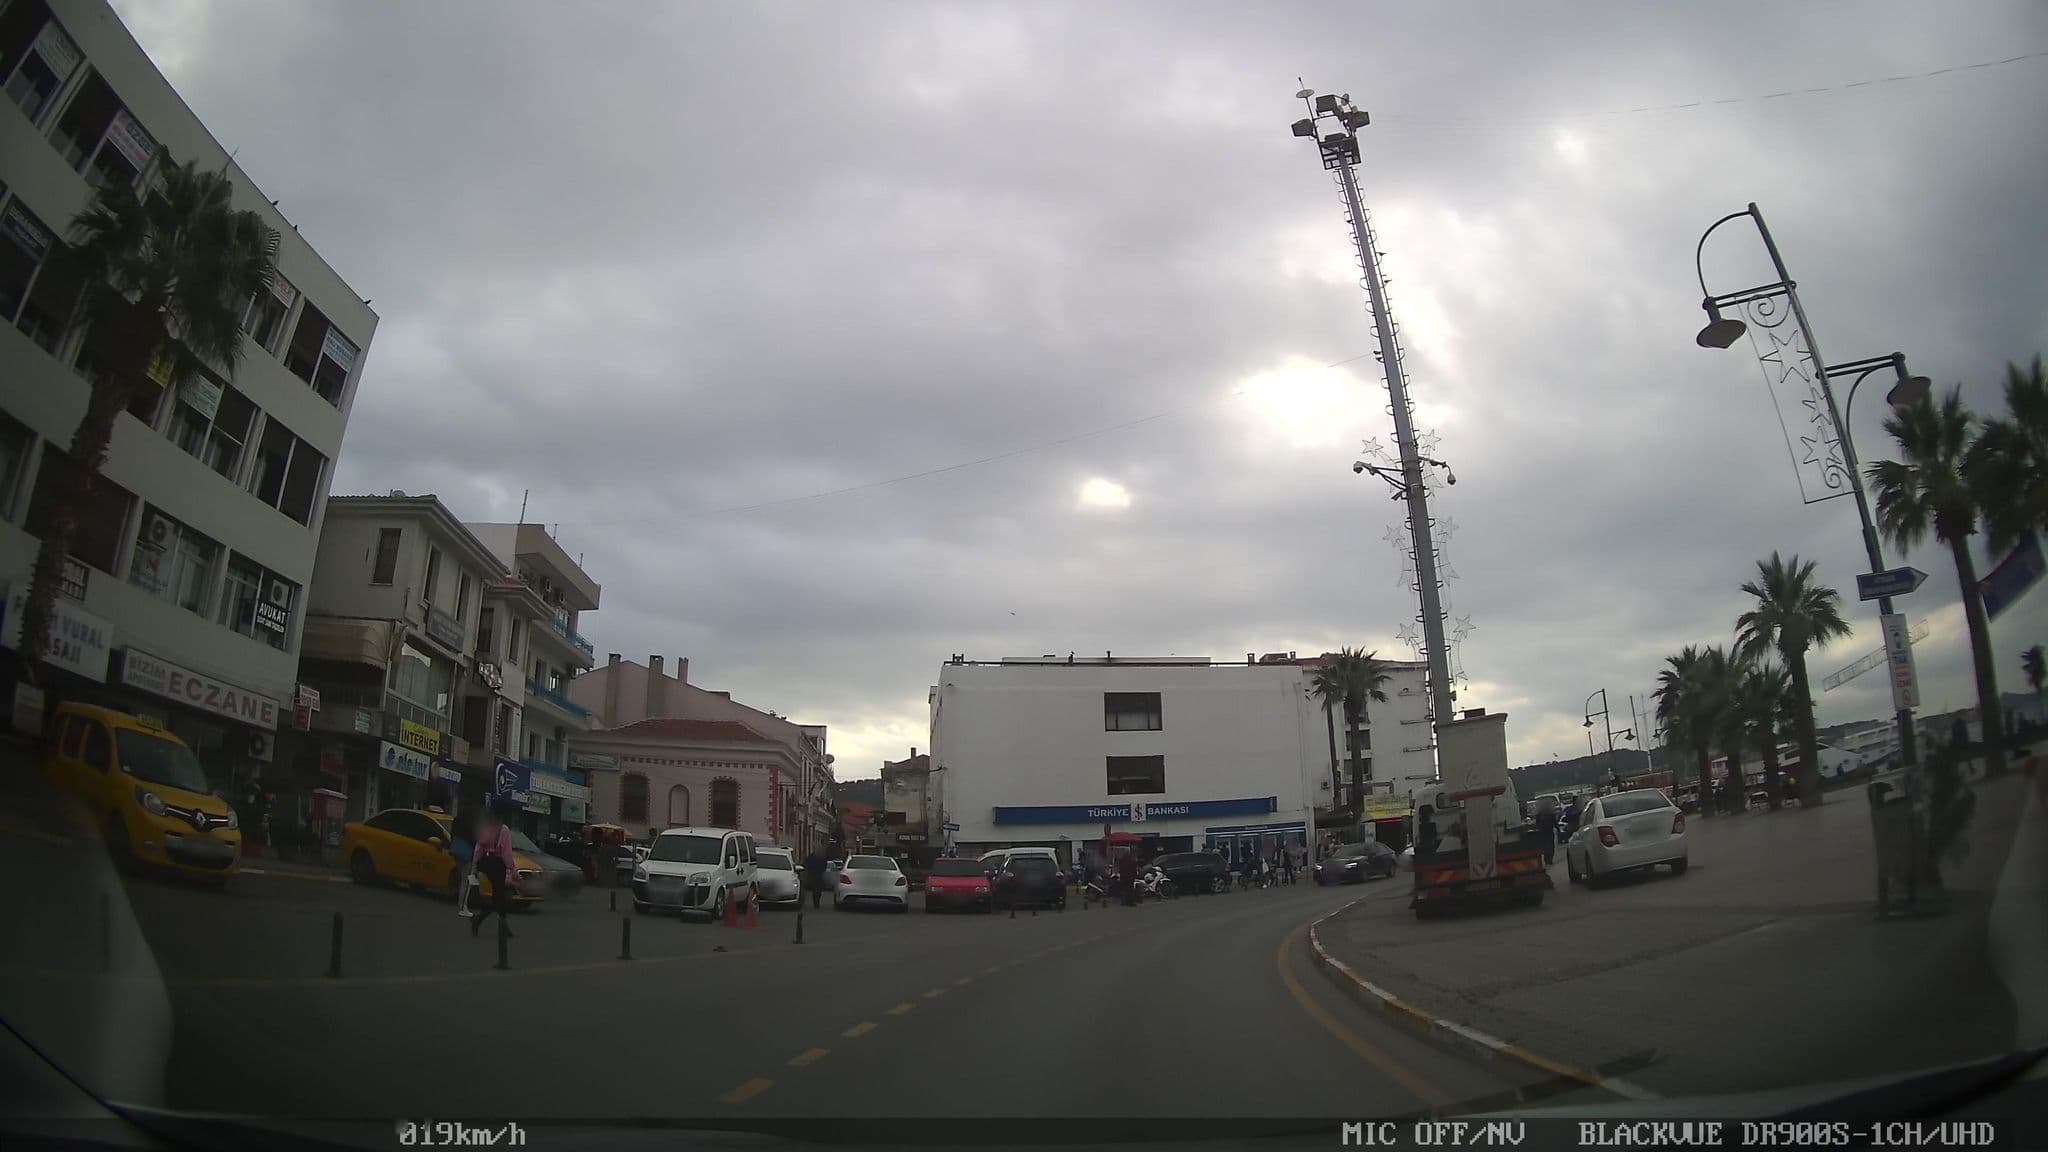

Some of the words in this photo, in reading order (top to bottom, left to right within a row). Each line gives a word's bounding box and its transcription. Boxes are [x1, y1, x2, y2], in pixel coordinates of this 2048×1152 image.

[258, 602, 287, 625] AVUKAT
[62, 615, 105, 649] VURAL
[49, 636, 81, 665] SAJI
[168, 671, 274, 723] ECZANE
[1087, 807, 1129, 818] TÜRKİYE
[1147, 806, 1189, 816] BANKASI
